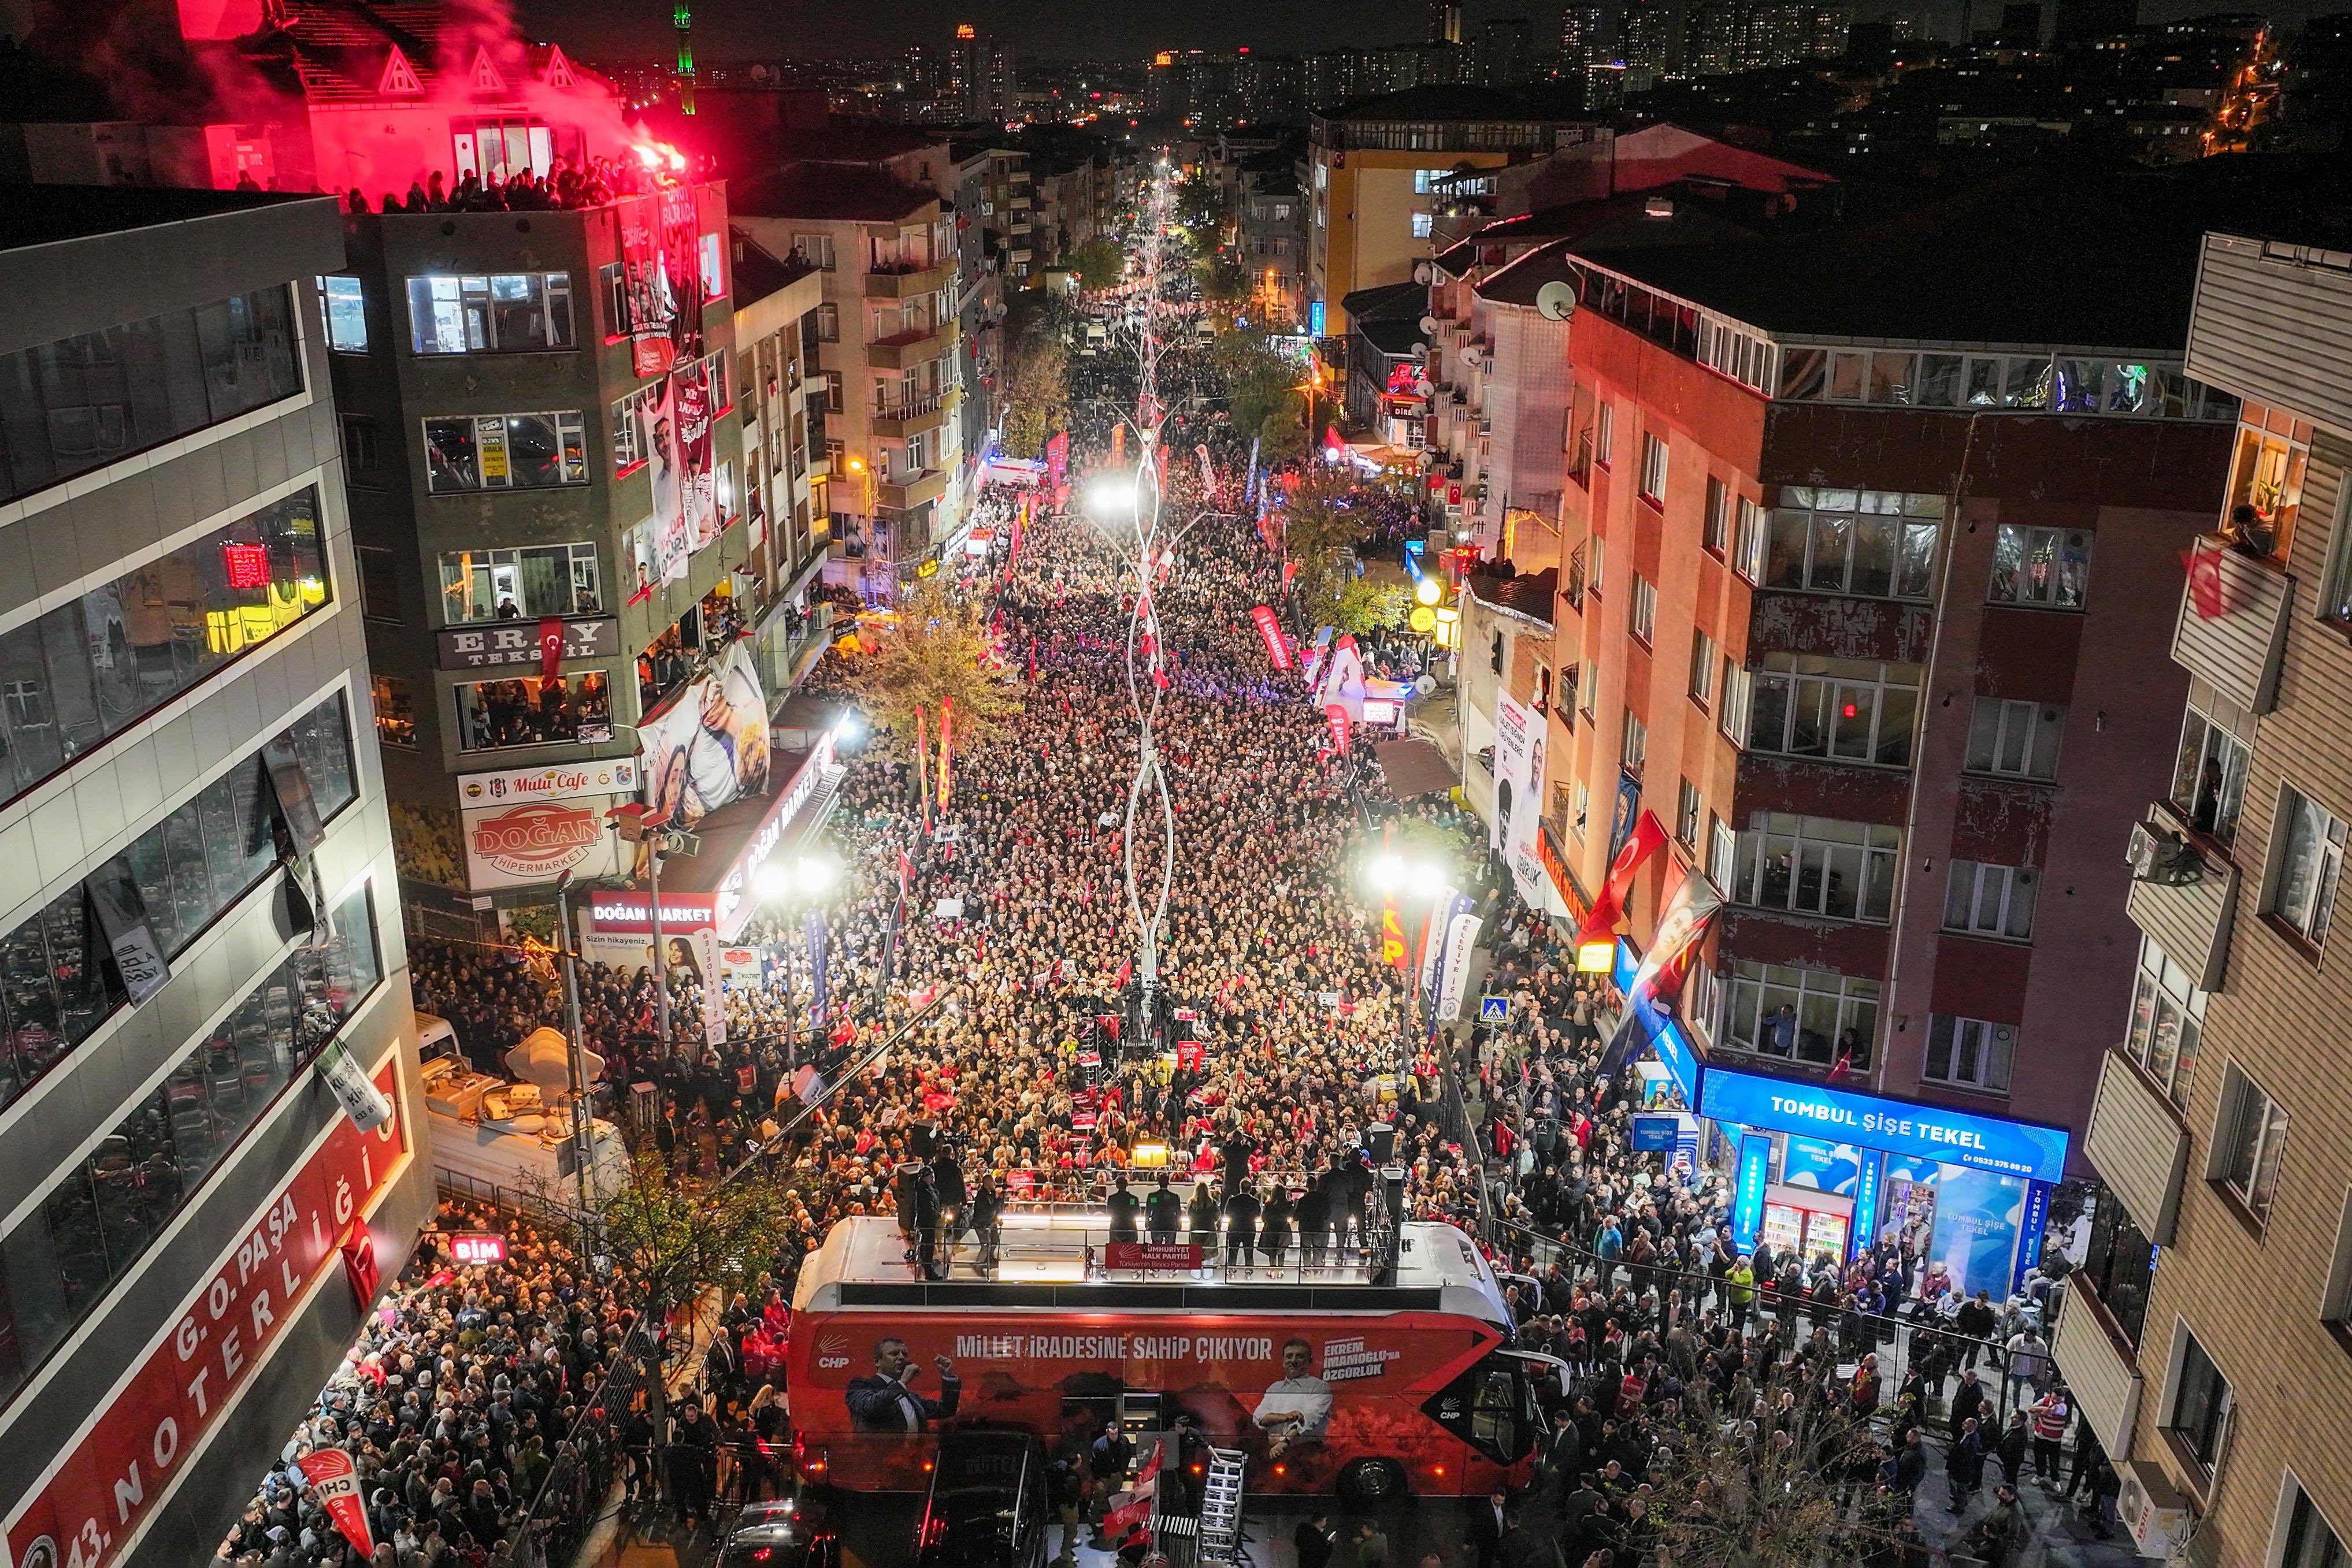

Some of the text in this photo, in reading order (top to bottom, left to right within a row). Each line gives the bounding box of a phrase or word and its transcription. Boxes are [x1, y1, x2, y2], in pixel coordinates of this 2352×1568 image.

[453, 622, 603, 653] ERY
[468, 644, 595, 666] TEKSİL
[557, 772, 588, 791] Cafe
[781, 767, 814, 830] MARKET
[473, 817, 603, 853] DOĞAN
[498, 849, 583, 872] HİPERMARKET
[593, 902, 646, 921] DOĞAN
[1453, 919, 1471, 973] BELEDİYE
[1771, 1096, 1987, 1151] TOMBUL ŞİŞE TEKEL
[1810, 1153, 1833, 1165] TEKEL
[1973, 1156, 1993, 1166] 0533
[1994, 1160, 2009, 1169] 375
[2021, 1164, 2032, 1173] 20
[2031, 1189, 2042, 1231] TOMBUL
[1947, 1212, 2006, 1232] TOMBUL ŞİŞE
[1961, 1224, 1989, 1236] TEKEL
[238, 1192, 298, 1287] PAŞA
[455, 1239, 500, 1259] BİM
[1162, 1252, 1190, 1260] PARTİSİ
[114, 1145, 373, 1526] NOTERLİĞİ
[956, 1335, 1272, 1363] MİLLET İRADESİNE SAHİP ÇIKIYOR
[1324, 1341, 1364, 1357] EKREM
[818, 1357, 849, 1369] CHP
[1322, 1363, 1382, 1381] ÖZGÜRLÜK
[2137, 1506, 2149, 1540] VESTEL
